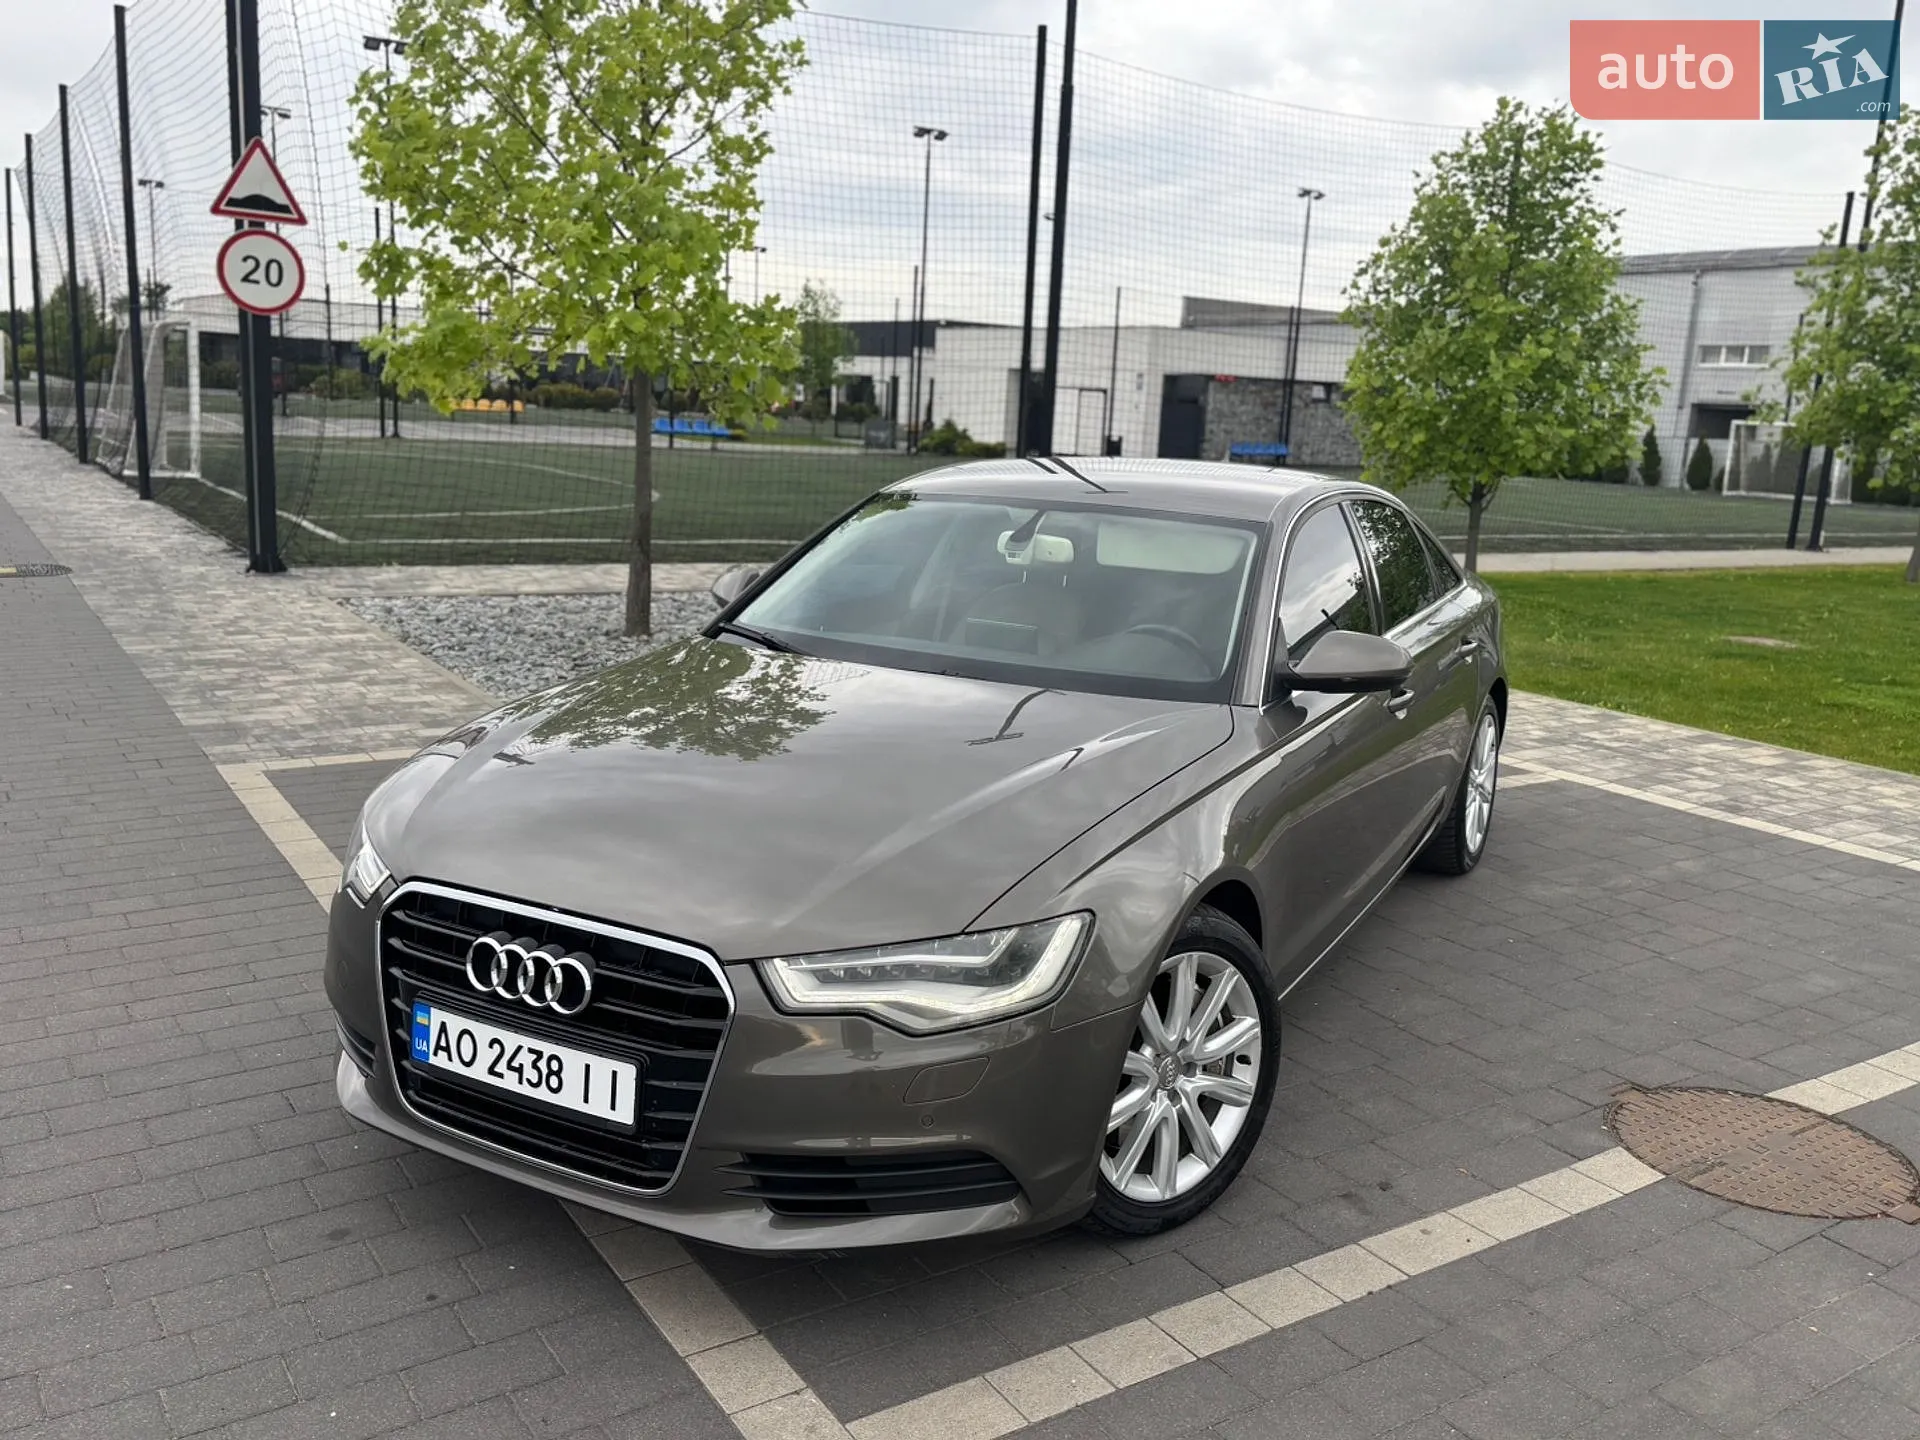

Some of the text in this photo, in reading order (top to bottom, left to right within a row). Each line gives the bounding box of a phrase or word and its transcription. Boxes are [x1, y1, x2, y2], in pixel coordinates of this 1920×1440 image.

[240, 254, 284, 288] 20
[414, 1037, 428, 1054] UA
[432, 1020, 478, 1068] AO
[487, 1037, 563, 1095] 2438
